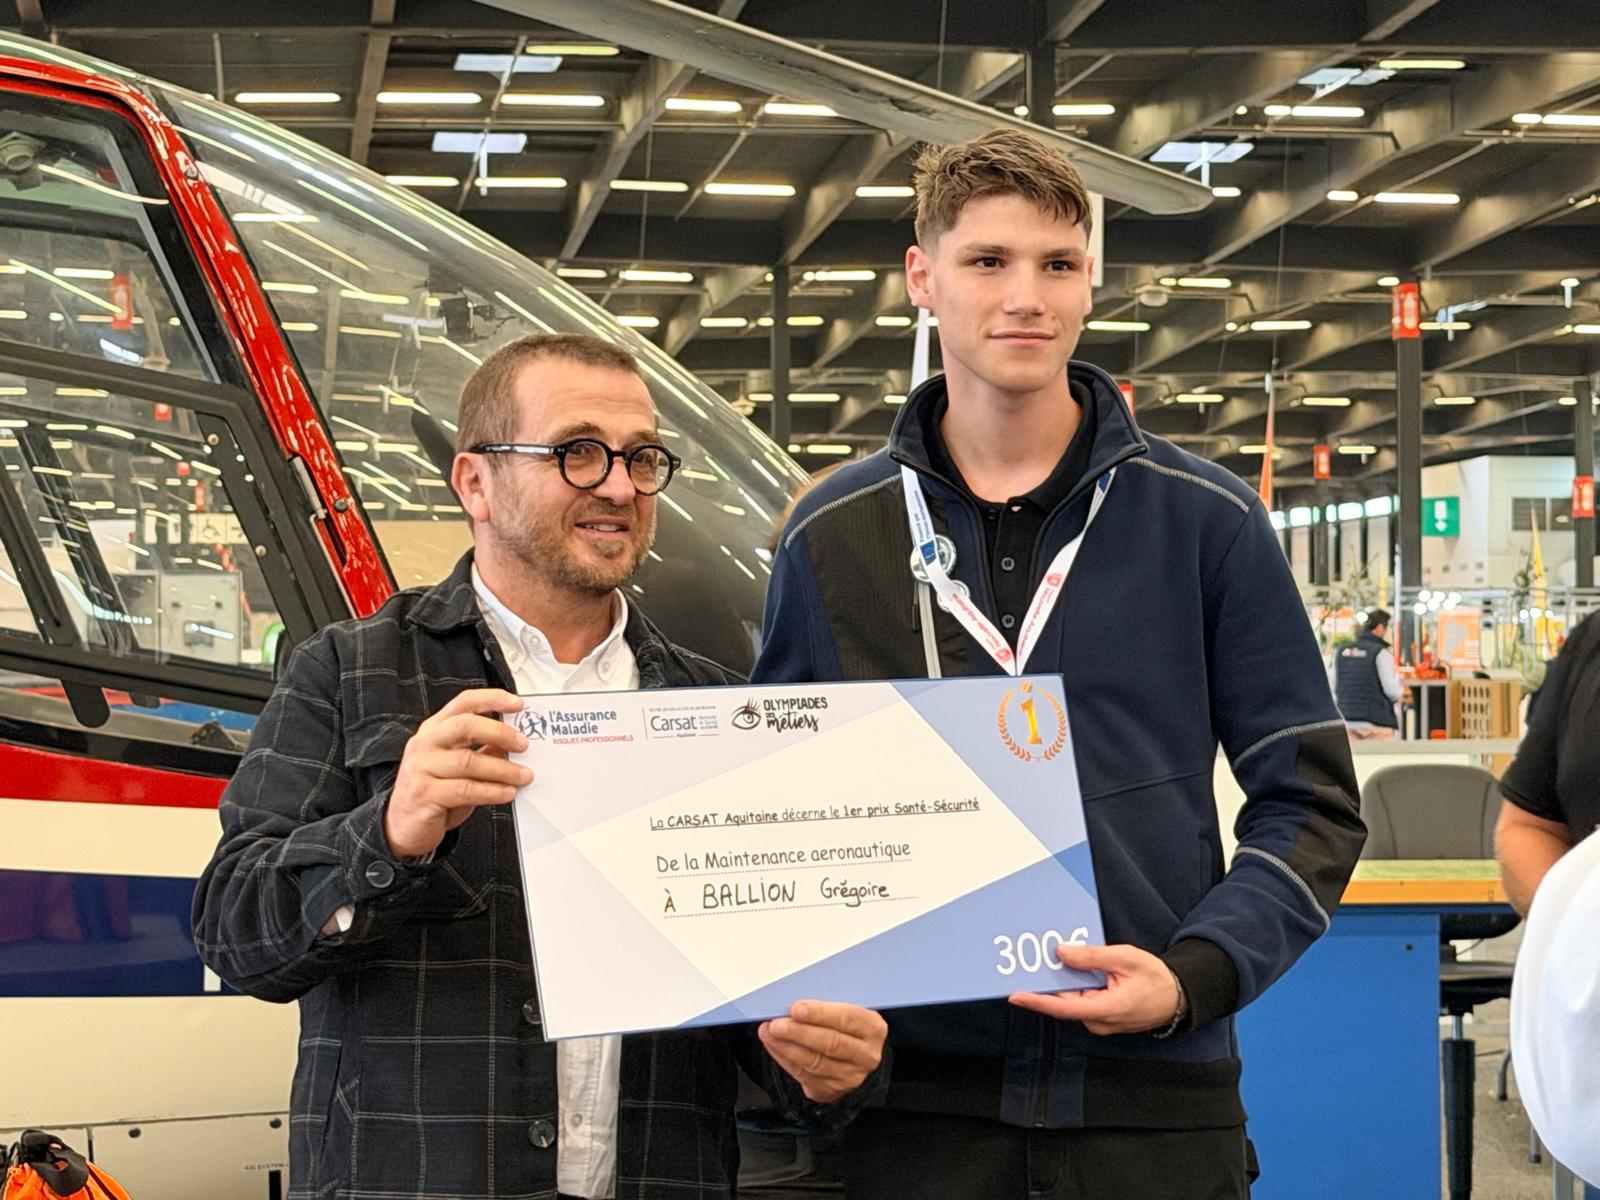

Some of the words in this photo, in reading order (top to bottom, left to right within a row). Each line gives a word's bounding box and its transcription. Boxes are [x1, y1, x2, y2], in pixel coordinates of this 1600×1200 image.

[763, 697, 828, 711] OLYMPIADES
[549, 710, 617, 723] l'Assurance
[650, 714, 698, 732] Carsat
[766, 710, 820, 734] métiers
[551, 722, 599, 736] Maladie
[581, 734, 634, 744] PROFESSIONNELS
[650, 816, 664, 830] La
[667, 812, 718, 828] CARSAT
[724, 810, 778, 827] Aquitaine
[781, 807, 827, 822] décerne
[830, 804, 841, 818] le
[843, 804, 864, 817] 1er
[867, 803, 890, 818] prix
[894, 796, 980, 815] Santé-Sécurité
[656, 855, 680, 873] De
[684, 852, 700, 870] la
[704, 849, 806, 870] Maintenance
[811, 841, 912, 862] aeronautique
[664, 887, 676, 913] À
[820, 876, 891, 908] Grégoire
